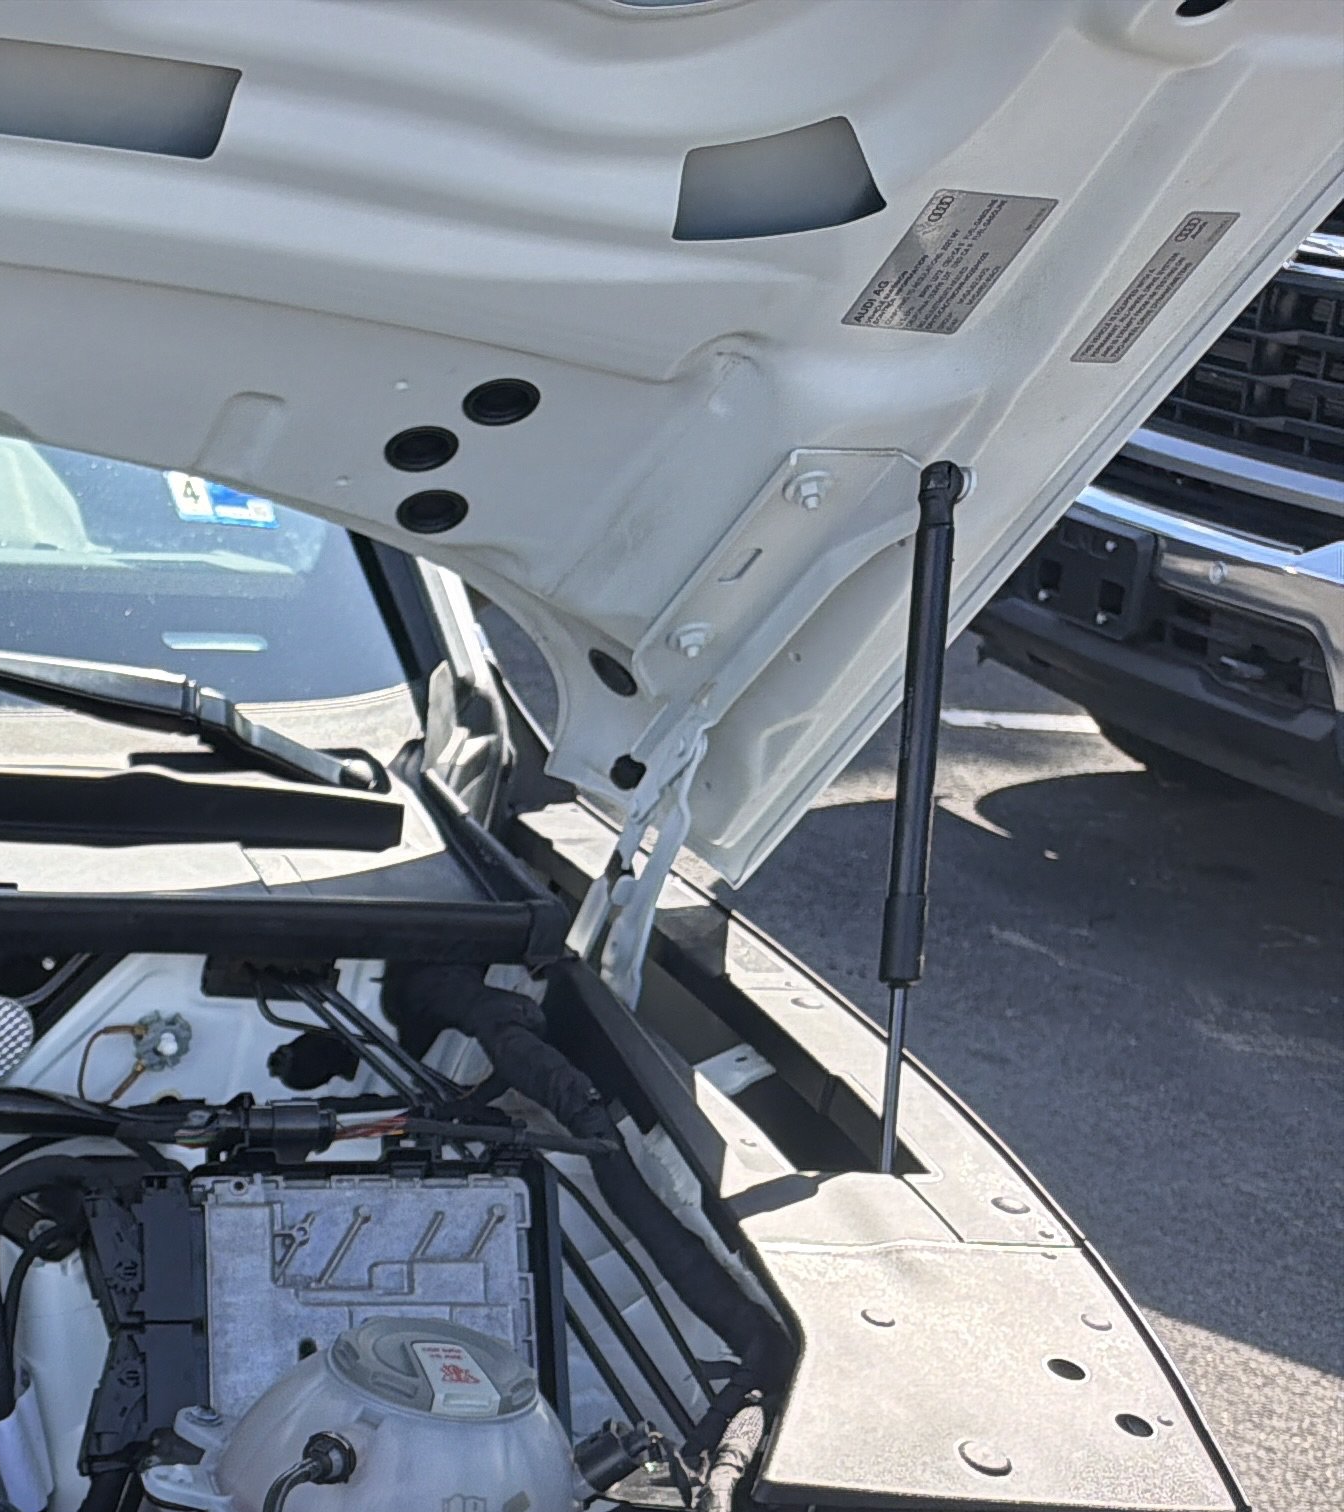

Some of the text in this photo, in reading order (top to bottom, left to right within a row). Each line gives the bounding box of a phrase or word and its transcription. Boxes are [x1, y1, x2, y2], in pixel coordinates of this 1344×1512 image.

[850, 280, 891, 323] AUDI AG
[183, 480, 200, 504] 4
